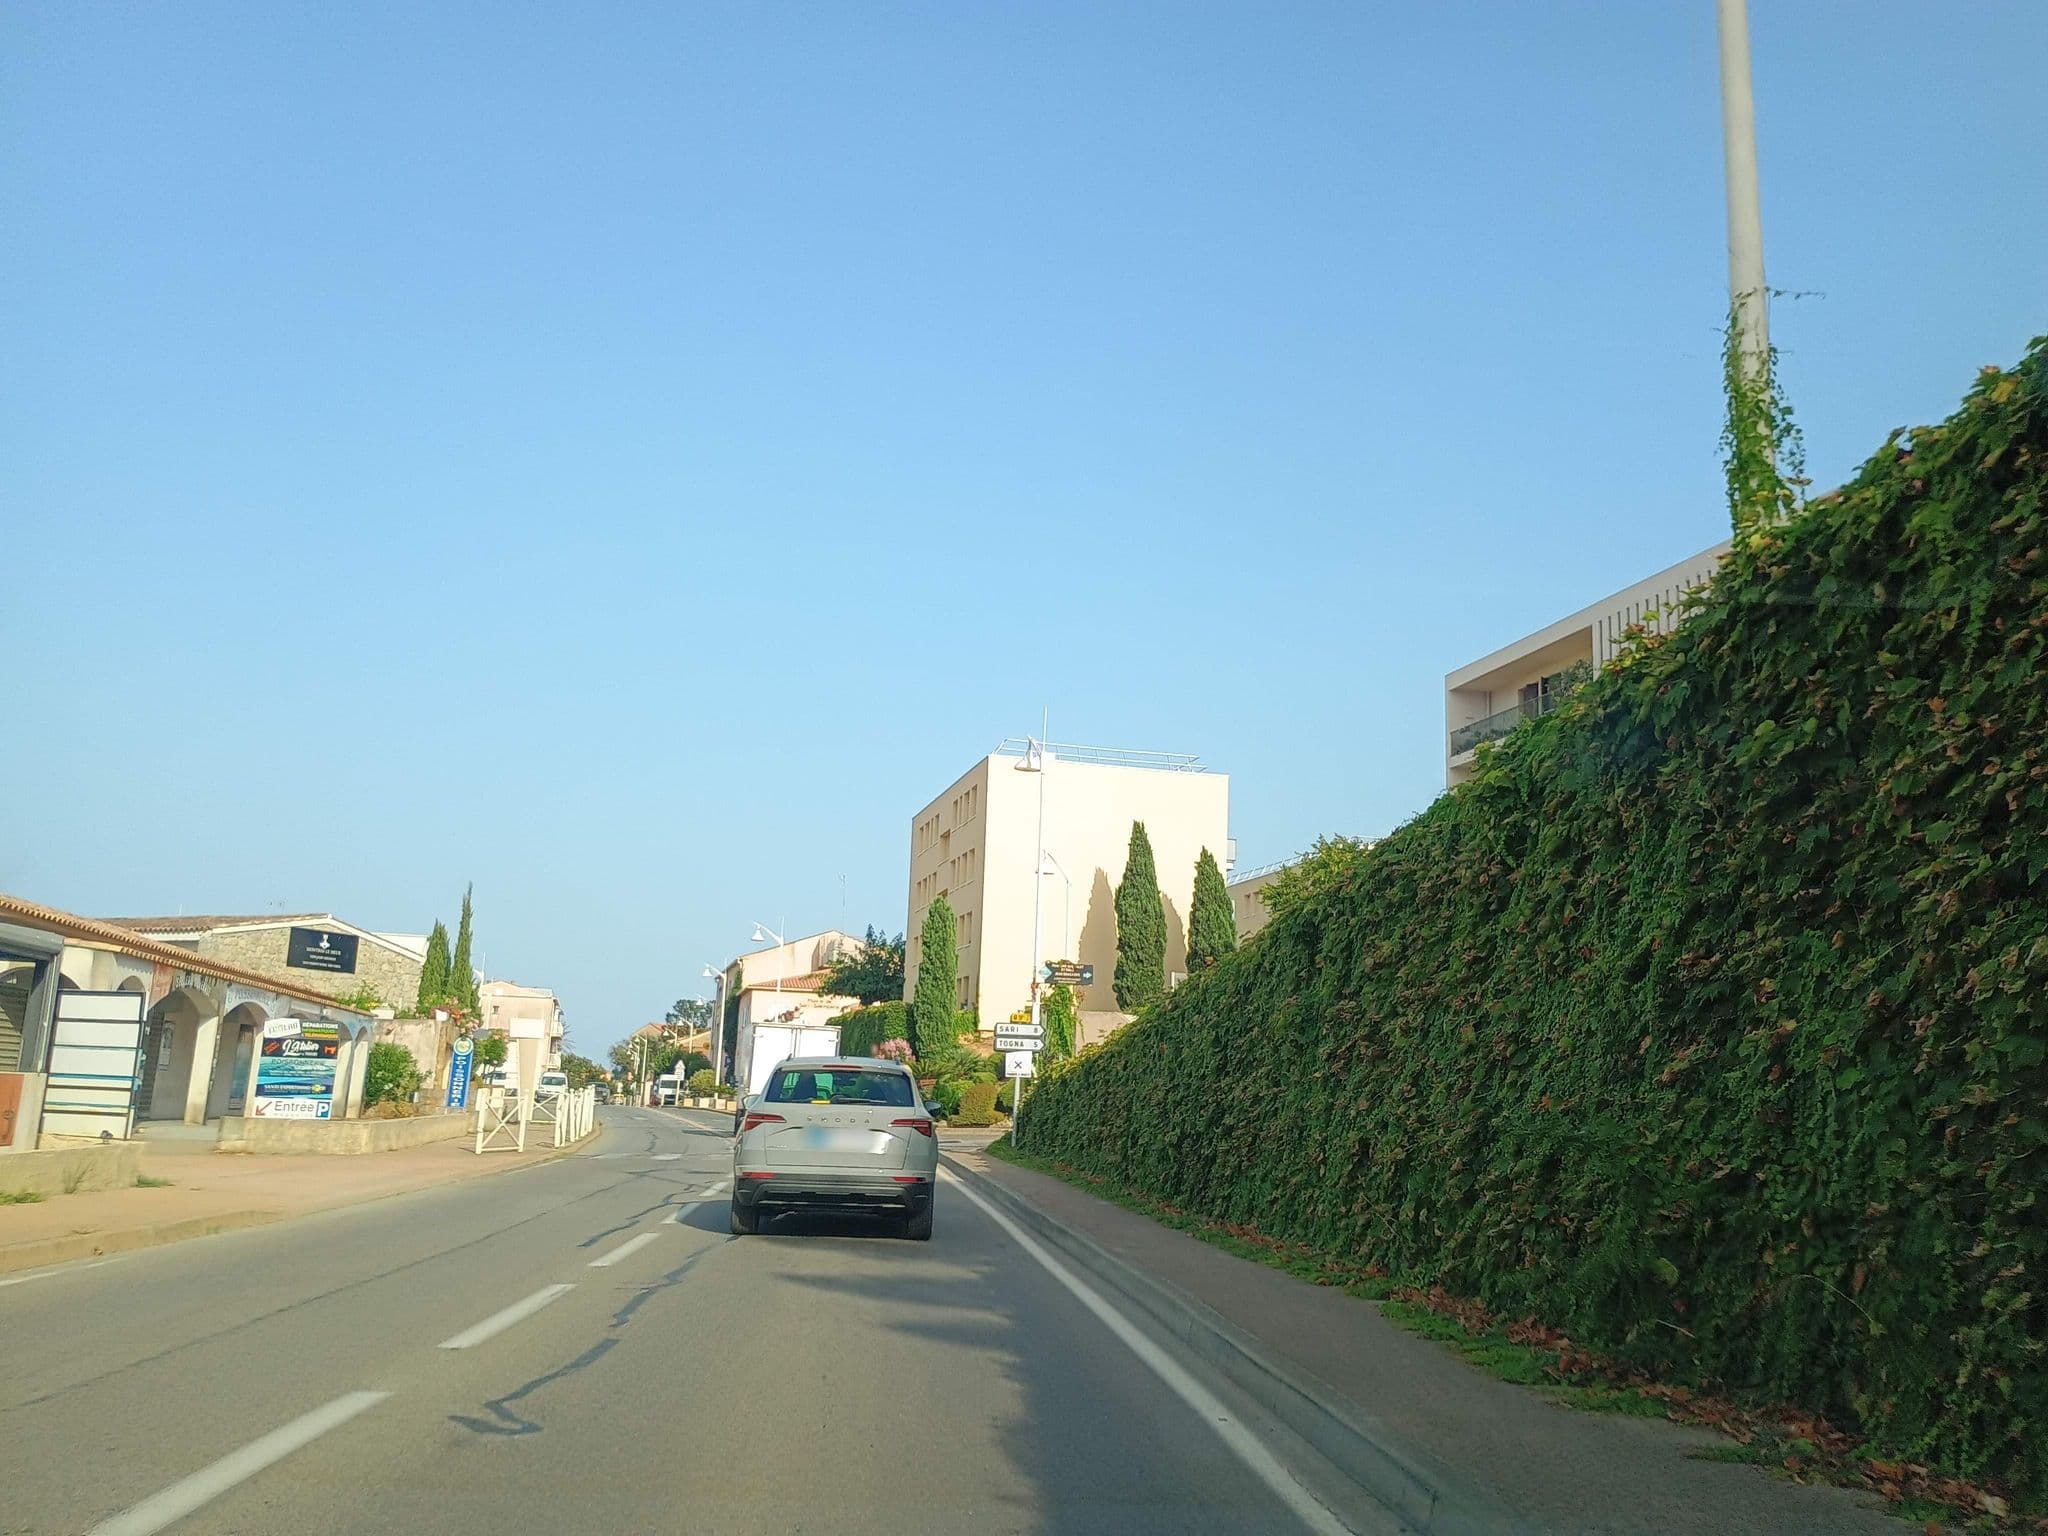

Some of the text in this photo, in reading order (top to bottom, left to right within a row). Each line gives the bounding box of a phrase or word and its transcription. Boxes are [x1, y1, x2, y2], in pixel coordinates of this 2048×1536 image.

[999, 1025, 1019, 1033] SARI
[999, 1040, 1025, 1048] TOGNA
[274, 1100, 315, 1112] Entrée
